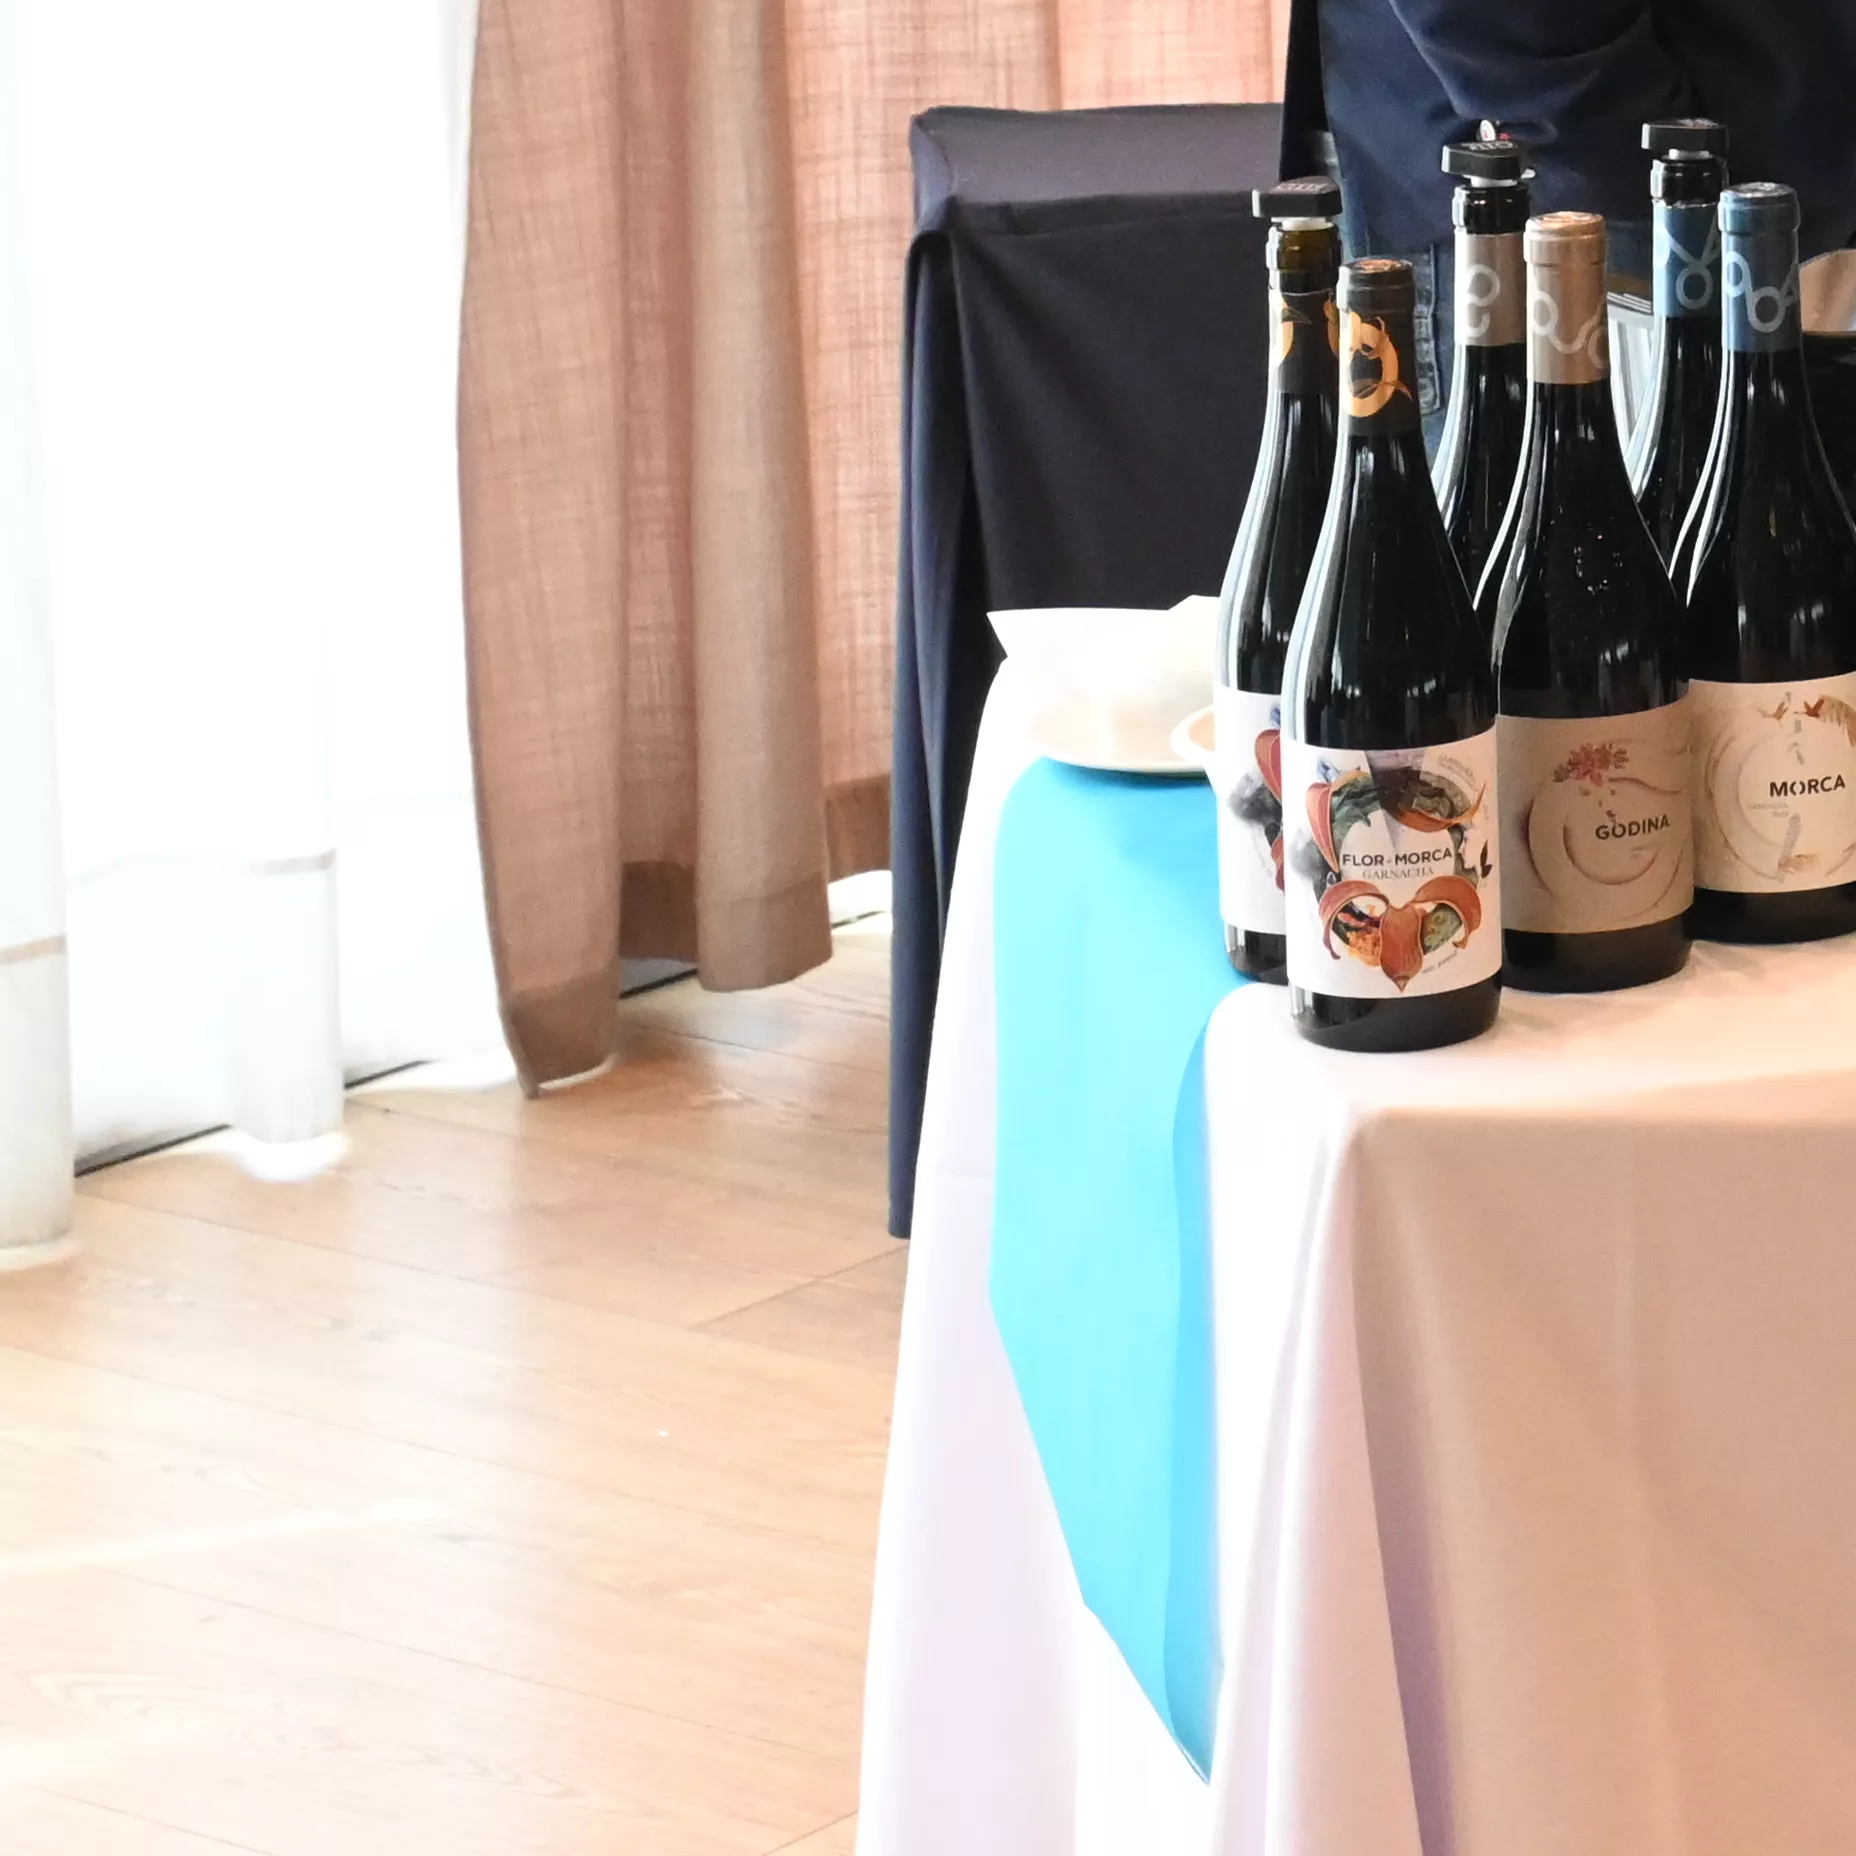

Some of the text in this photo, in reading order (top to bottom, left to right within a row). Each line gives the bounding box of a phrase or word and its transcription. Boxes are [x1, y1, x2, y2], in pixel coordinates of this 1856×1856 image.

[1769, 774, 1846, 798] MORCA
[1595, 813, 1670, 841] GODINA
[1342, 854, 1385, 868] FLOR
[1394, 848, 1453, 867] MORCA
[1362, 867, 1436, 881] GARNACHA
